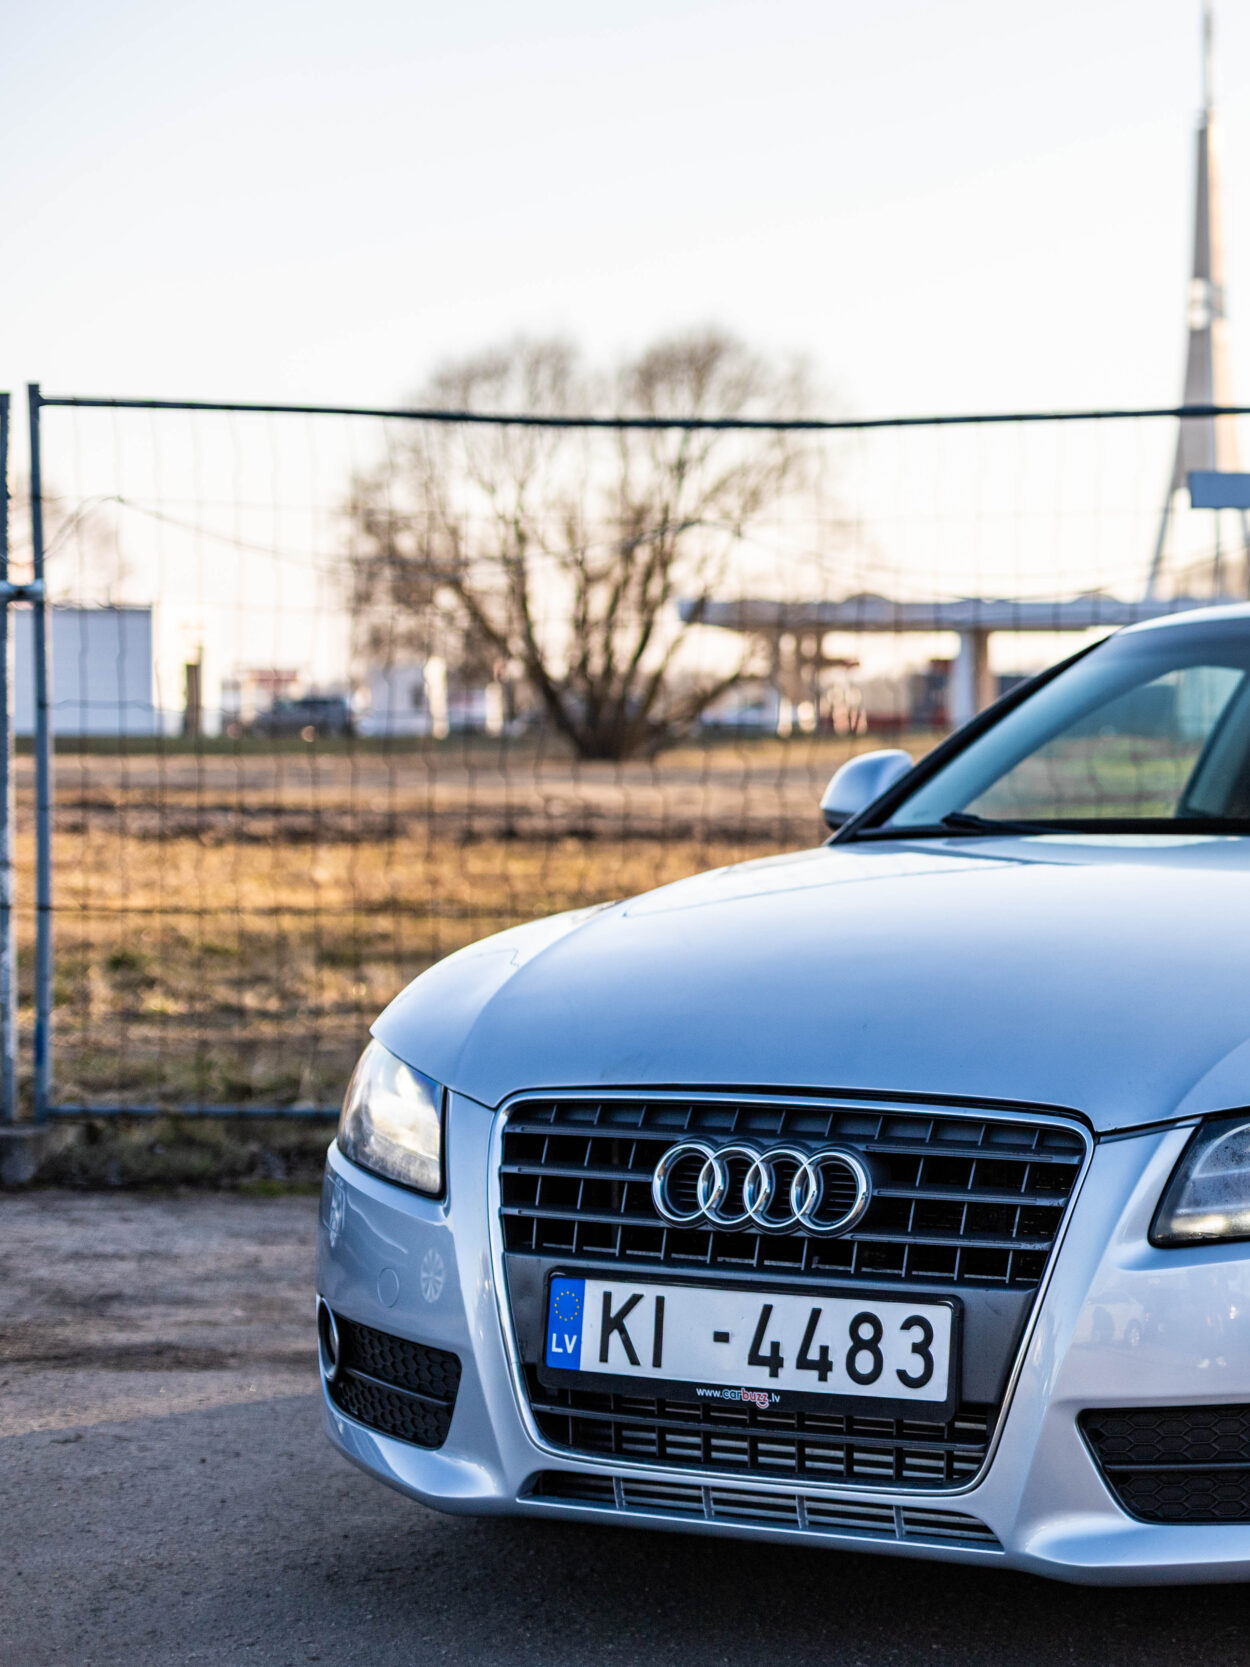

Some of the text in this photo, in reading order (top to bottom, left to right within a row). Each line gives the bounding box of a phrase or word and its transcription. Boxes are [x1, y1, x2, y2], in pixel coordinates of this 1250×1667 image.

[599, 1291, 665, 1368] KI
[551, 1333, 577, 1354] LV
[695, 1387, 780, 1404] www.carbuzz.lv
